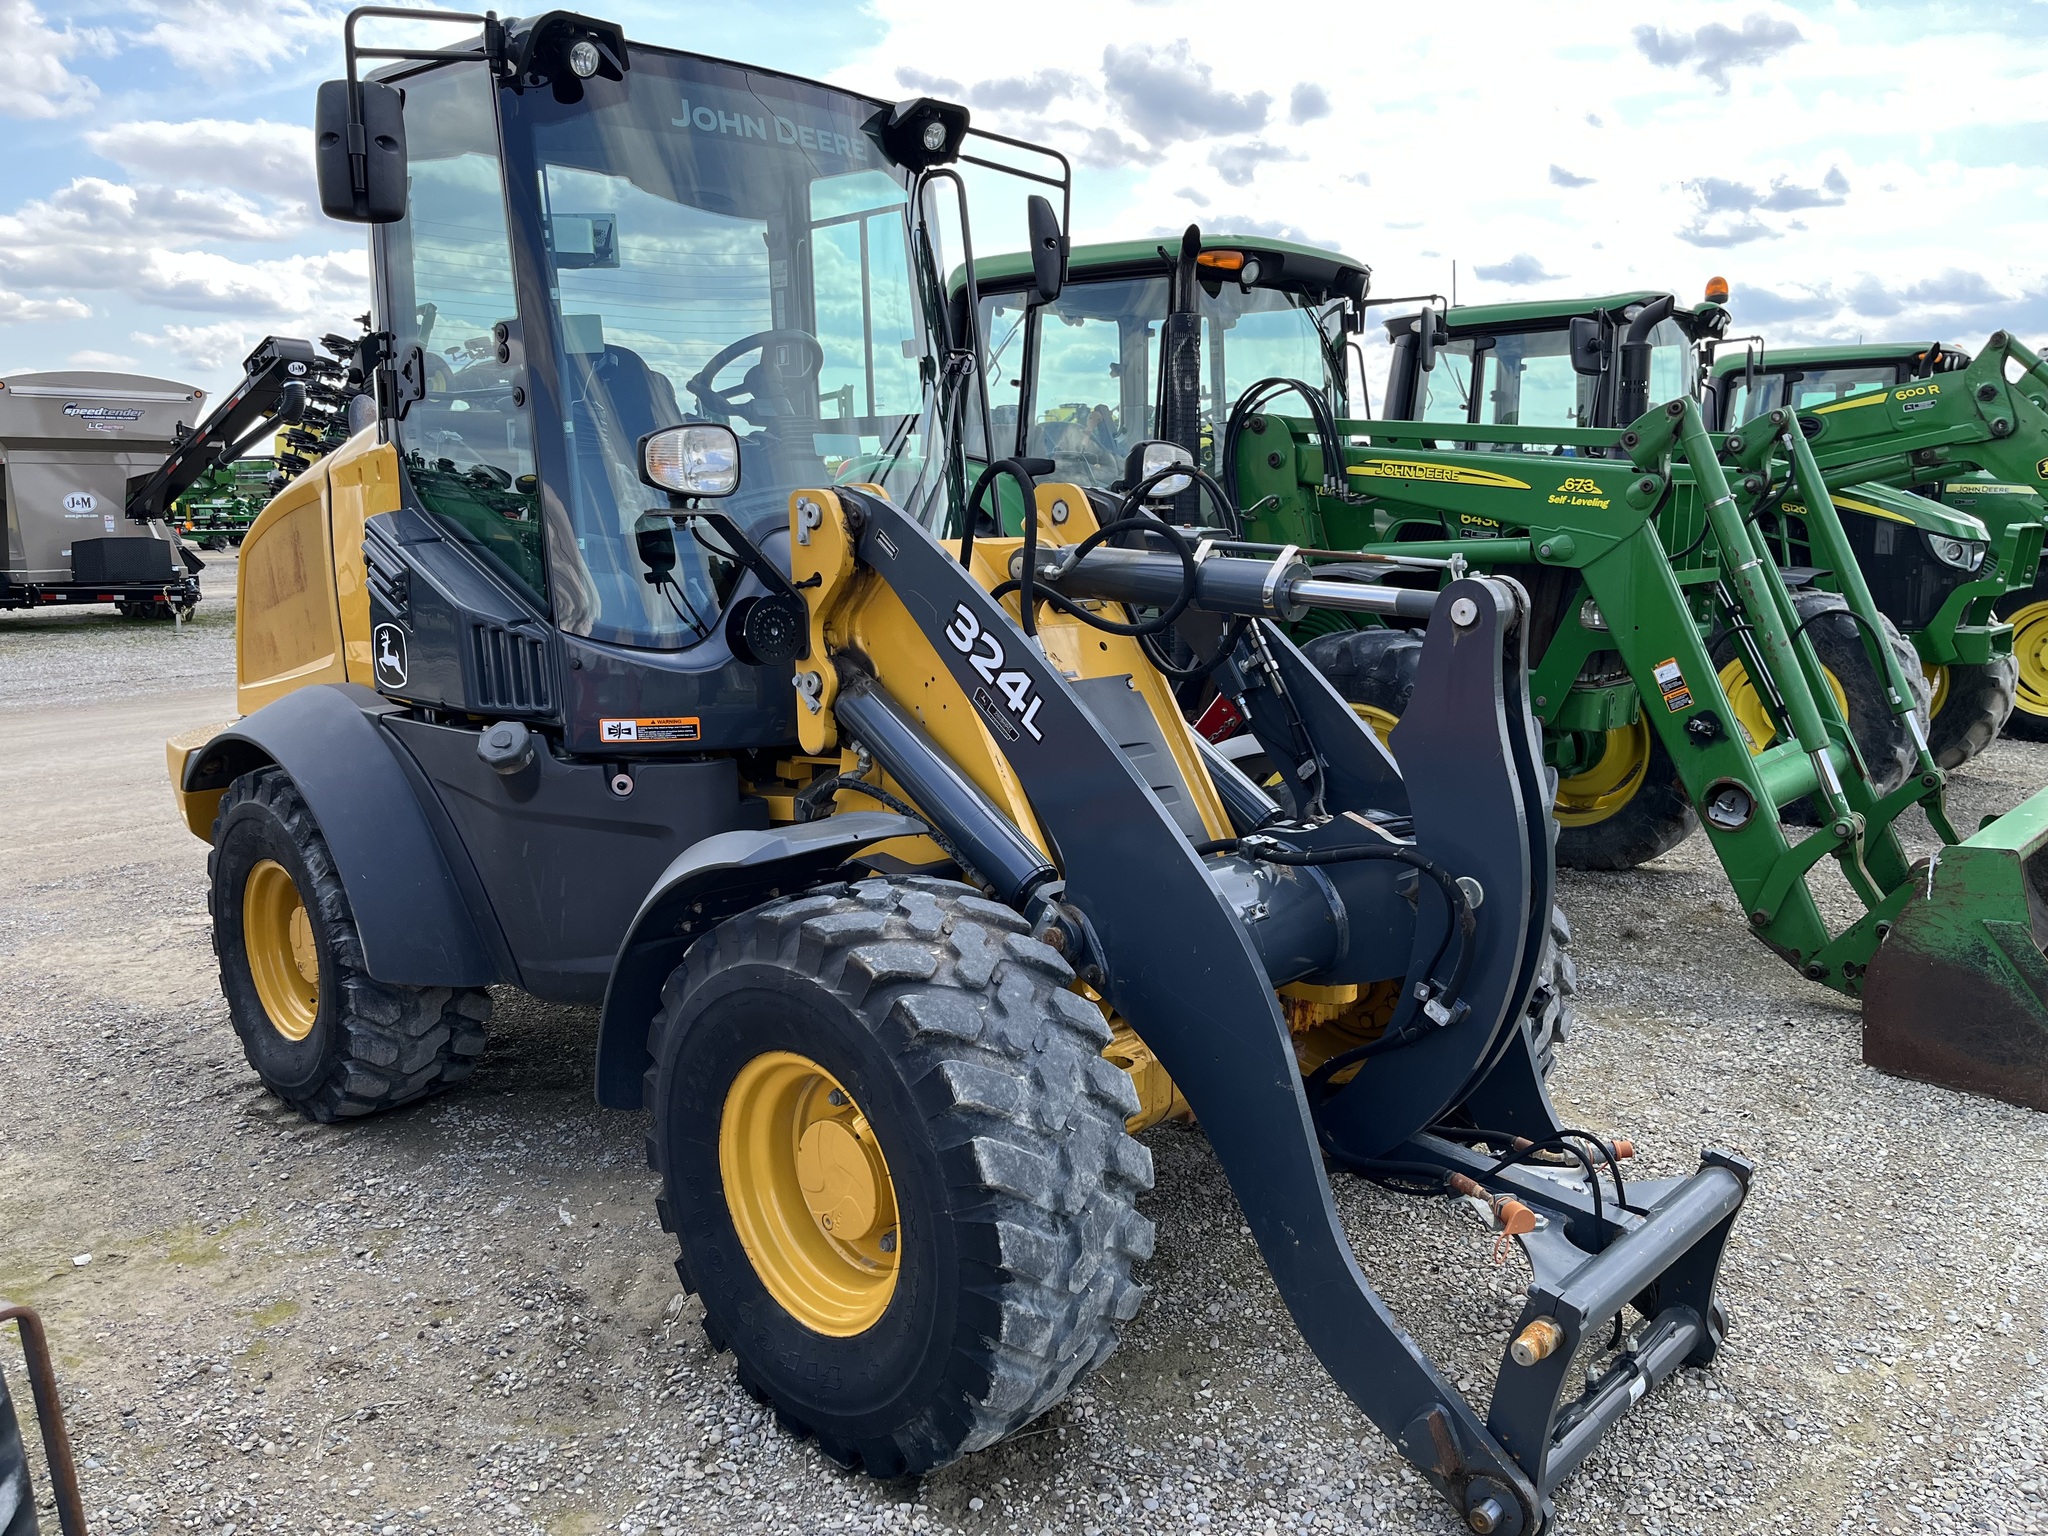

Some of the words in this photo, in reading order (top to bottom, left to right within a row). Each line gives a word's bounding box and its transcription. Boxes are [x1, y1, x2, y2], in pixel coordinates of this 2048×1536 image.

[672, 99, 767, 141] JOHN
[775, 114, 868, 161] DEERE
[290, 364, 304, 373] J&M
[1895, 387, 1926, 401] 600
[1927, 384, 1941, 395] R
[1375, 462, 1414, 478] JOHN
[1415, 465, 1459, 481] DEERE
[1563, 477, 1595, 492] 673
[67, 496, 91, 509] J&M
[1781, 503, 1807, 515] 6120
[944, 602, 1045, 743] 324L
